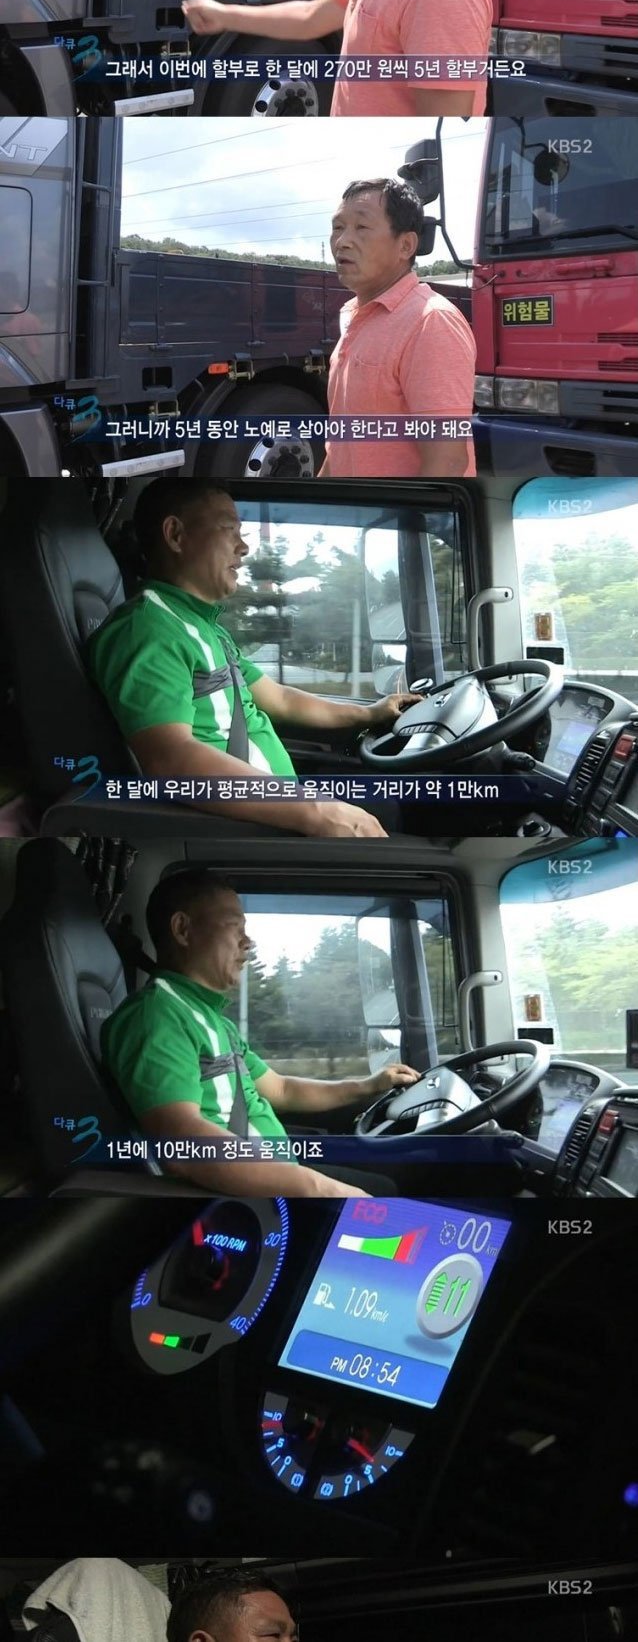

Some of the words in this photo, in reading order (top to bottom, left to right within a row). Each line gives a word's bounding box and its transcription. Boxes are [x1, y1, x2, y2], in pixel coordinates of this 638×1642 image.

[503, 299, 550, 320] 위험물
[264, 1232, 281, 1247] 30
[457, 1218, 491, 1254] 00
[444, 1276, 471, 1318] 11
[230, 1316, 246, 1330] 40
[330, 1356, 347, 1374] PM
[349, 1353, 402, 1386] 08:54
